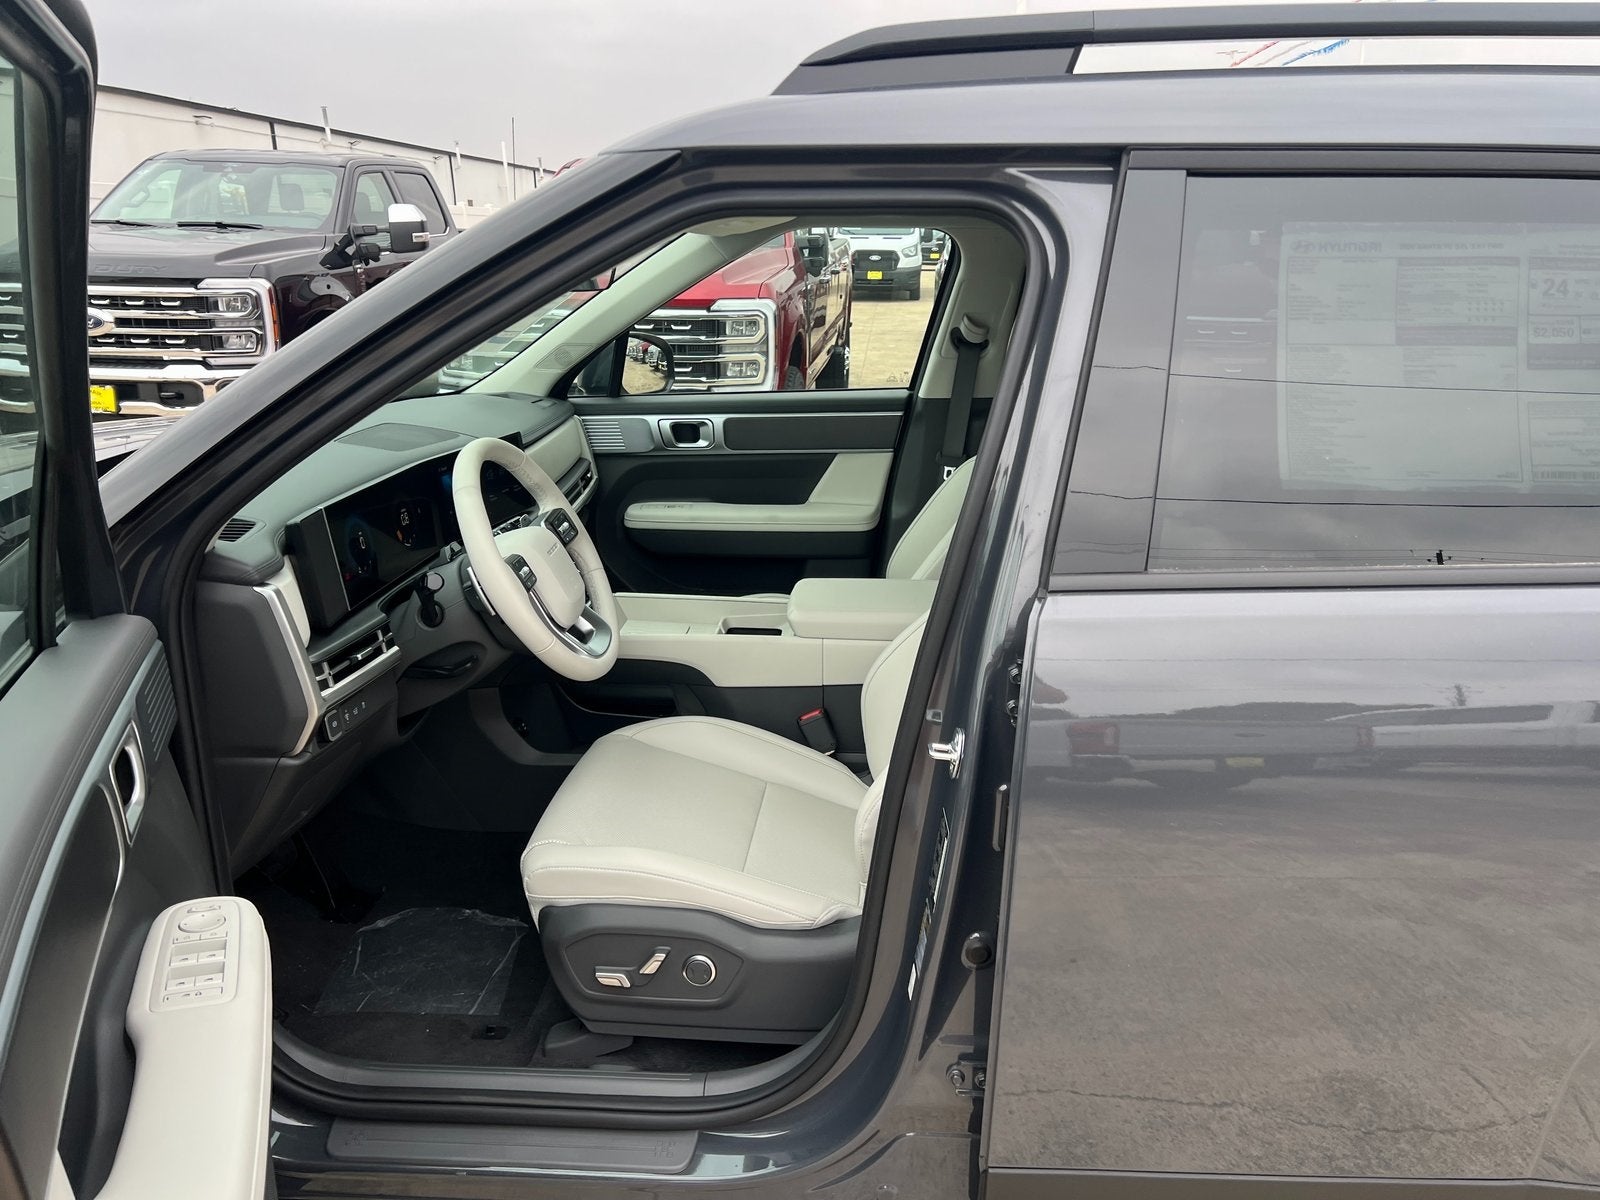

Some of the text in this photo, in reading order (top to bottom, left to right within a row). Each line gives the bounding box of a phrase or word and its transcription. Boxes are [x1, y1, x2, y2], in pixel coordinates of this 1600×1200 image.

[1318, 240, 1382, 253] HYUNDAI
[95, 262, 169, 275] DUTY
[1542, 278, 1570, 297] 24
